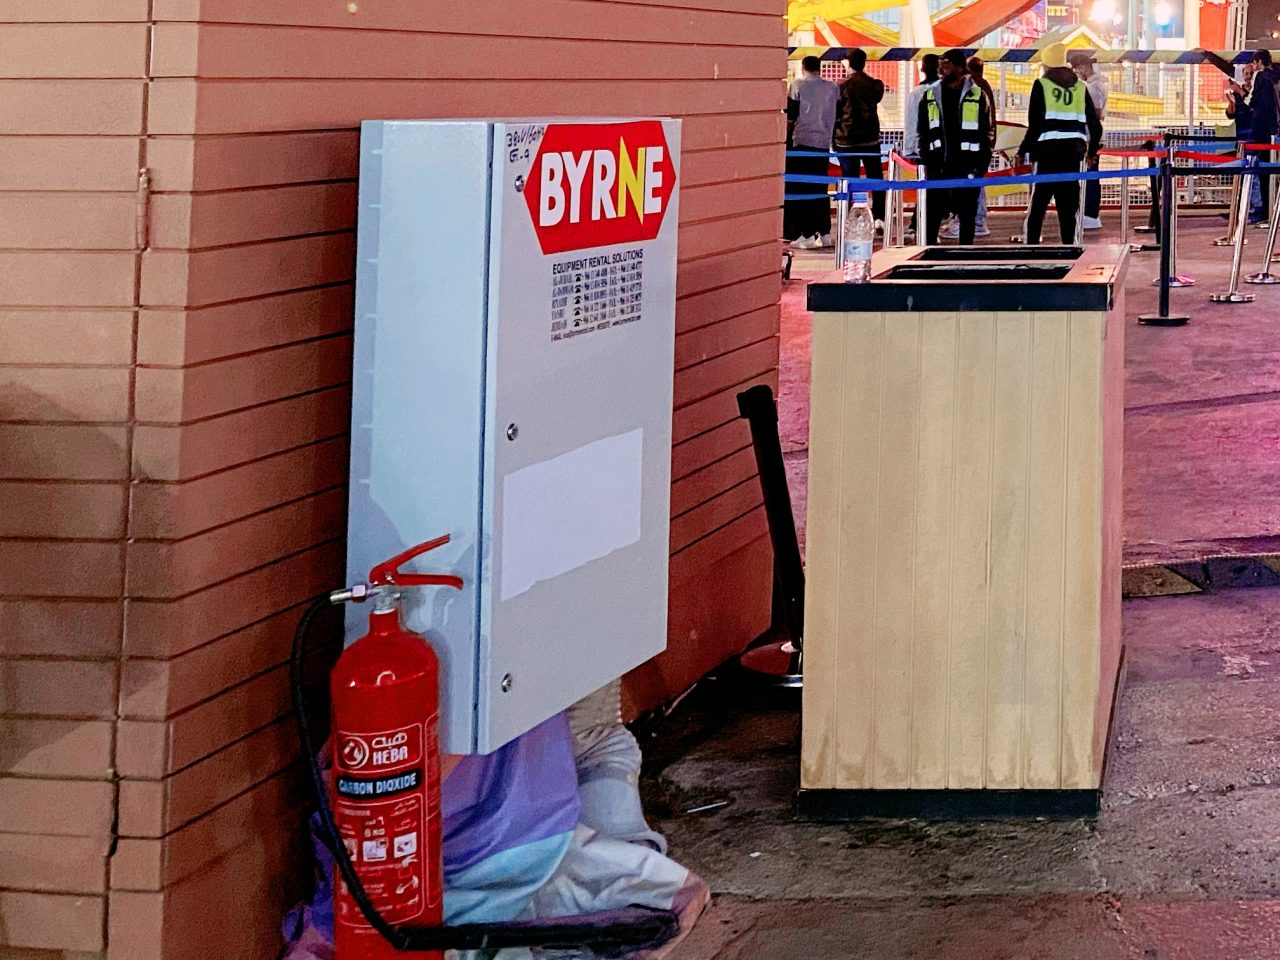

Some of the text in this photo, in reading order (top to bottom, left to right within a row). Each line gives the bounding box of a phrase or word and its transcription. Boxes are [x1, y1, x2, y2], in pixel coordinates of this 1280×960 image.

[1052, 87, 1074, 106] 90
[539, 135, 664, 227] BYRNE
[552, 248, 643, 275] EQUIPMENT RENTAL SOLUTIONS
[373, 746, 408, 765] HEBA
[339, 772, 417, 795] CARBON DIOXIDE
